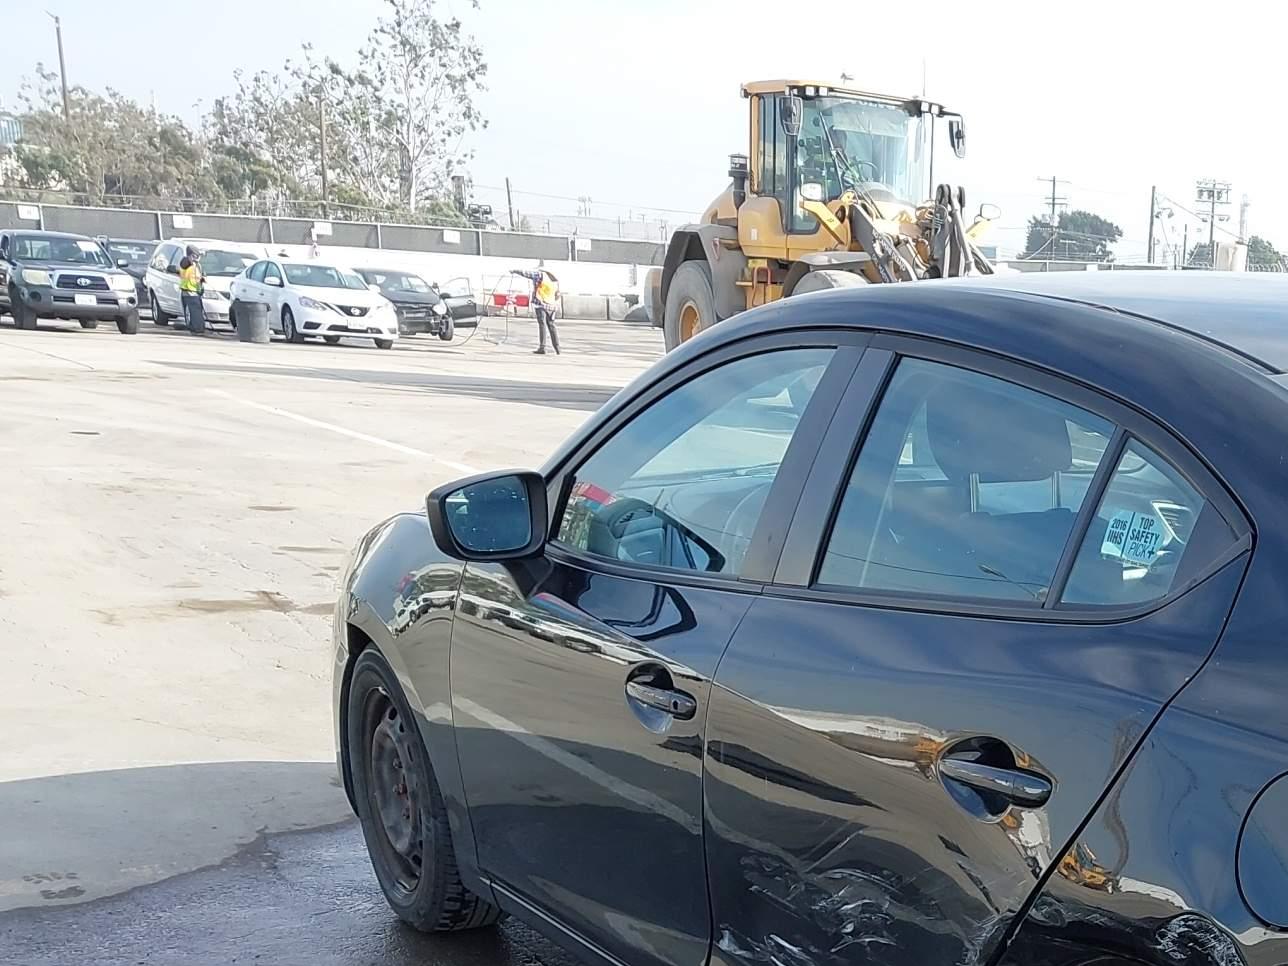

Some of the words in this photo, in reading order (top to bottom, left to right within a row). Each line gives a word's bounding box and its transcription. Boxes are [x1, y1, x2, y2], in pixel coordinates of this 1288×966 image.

[1111, 518, 1128, 530] 2016
[1139, 517, 1155, 530] TOP
[1106, 529, 1124, 545] IIHS
[1130, 528, 1160, 545] SAFETY
